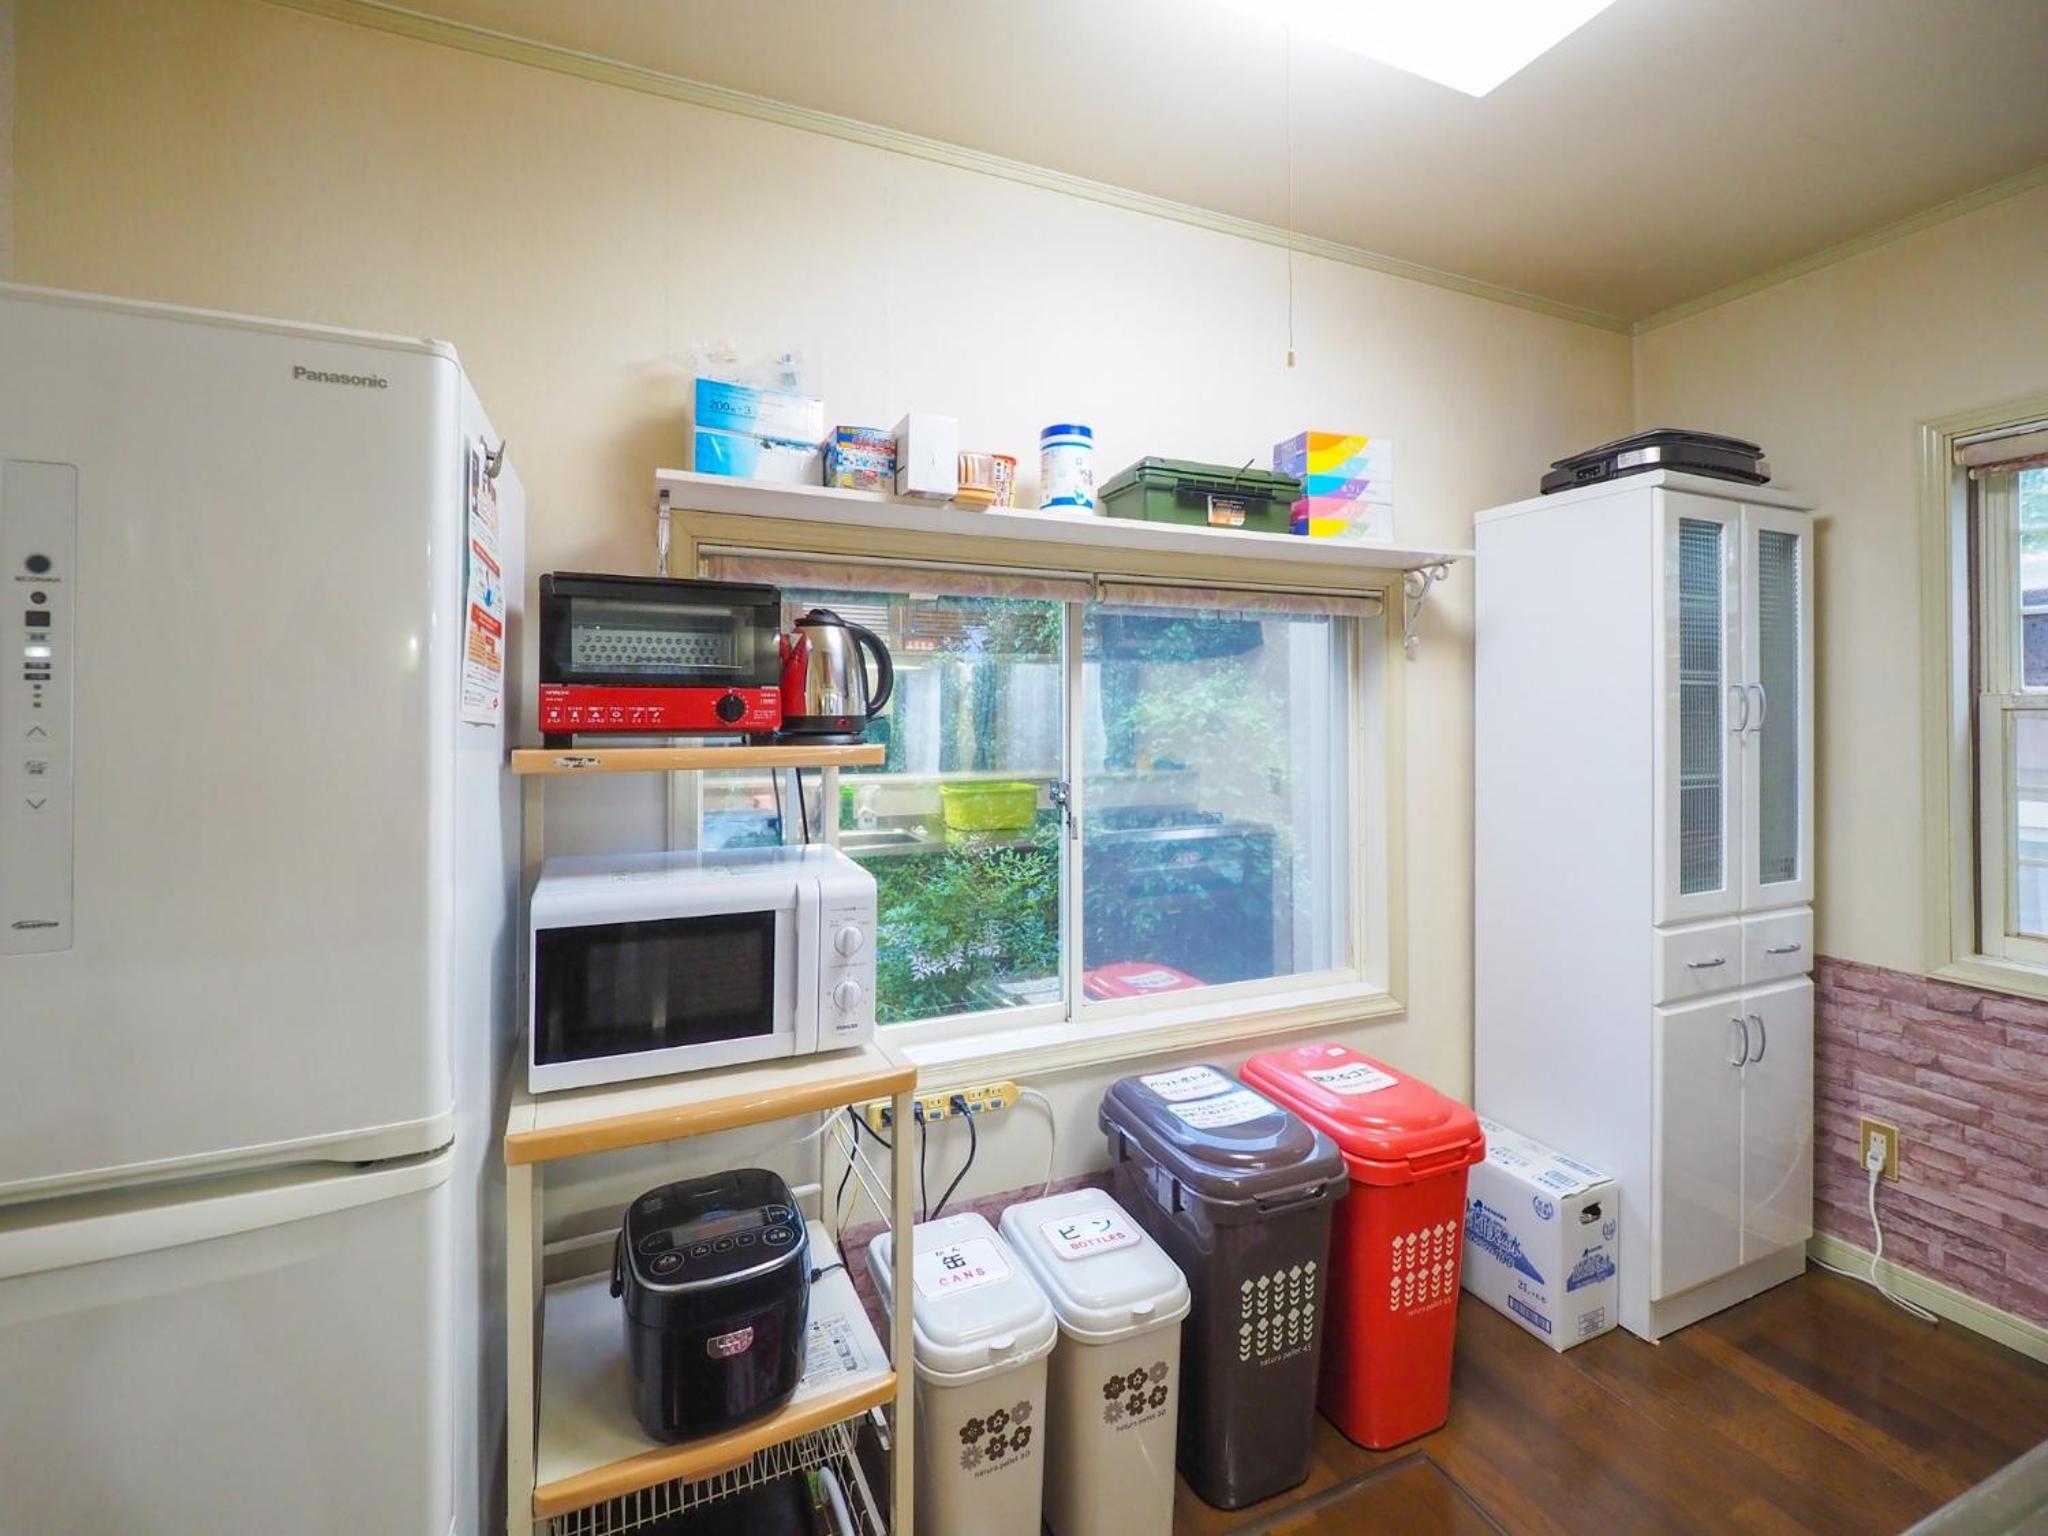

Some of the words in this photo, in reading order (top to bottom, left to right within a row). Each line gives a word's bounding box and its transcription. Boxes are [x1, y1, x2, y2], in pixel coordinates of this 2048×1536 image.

[293, 365, 388, 389] Panasonic
[1058, 1219, 1111, 1240] ビン
[1069, 1232, 1126, 1250] BOTTLES
[942, 1254, 966, 1270] 缶
[939, 1267, 986, 1286] CANS
